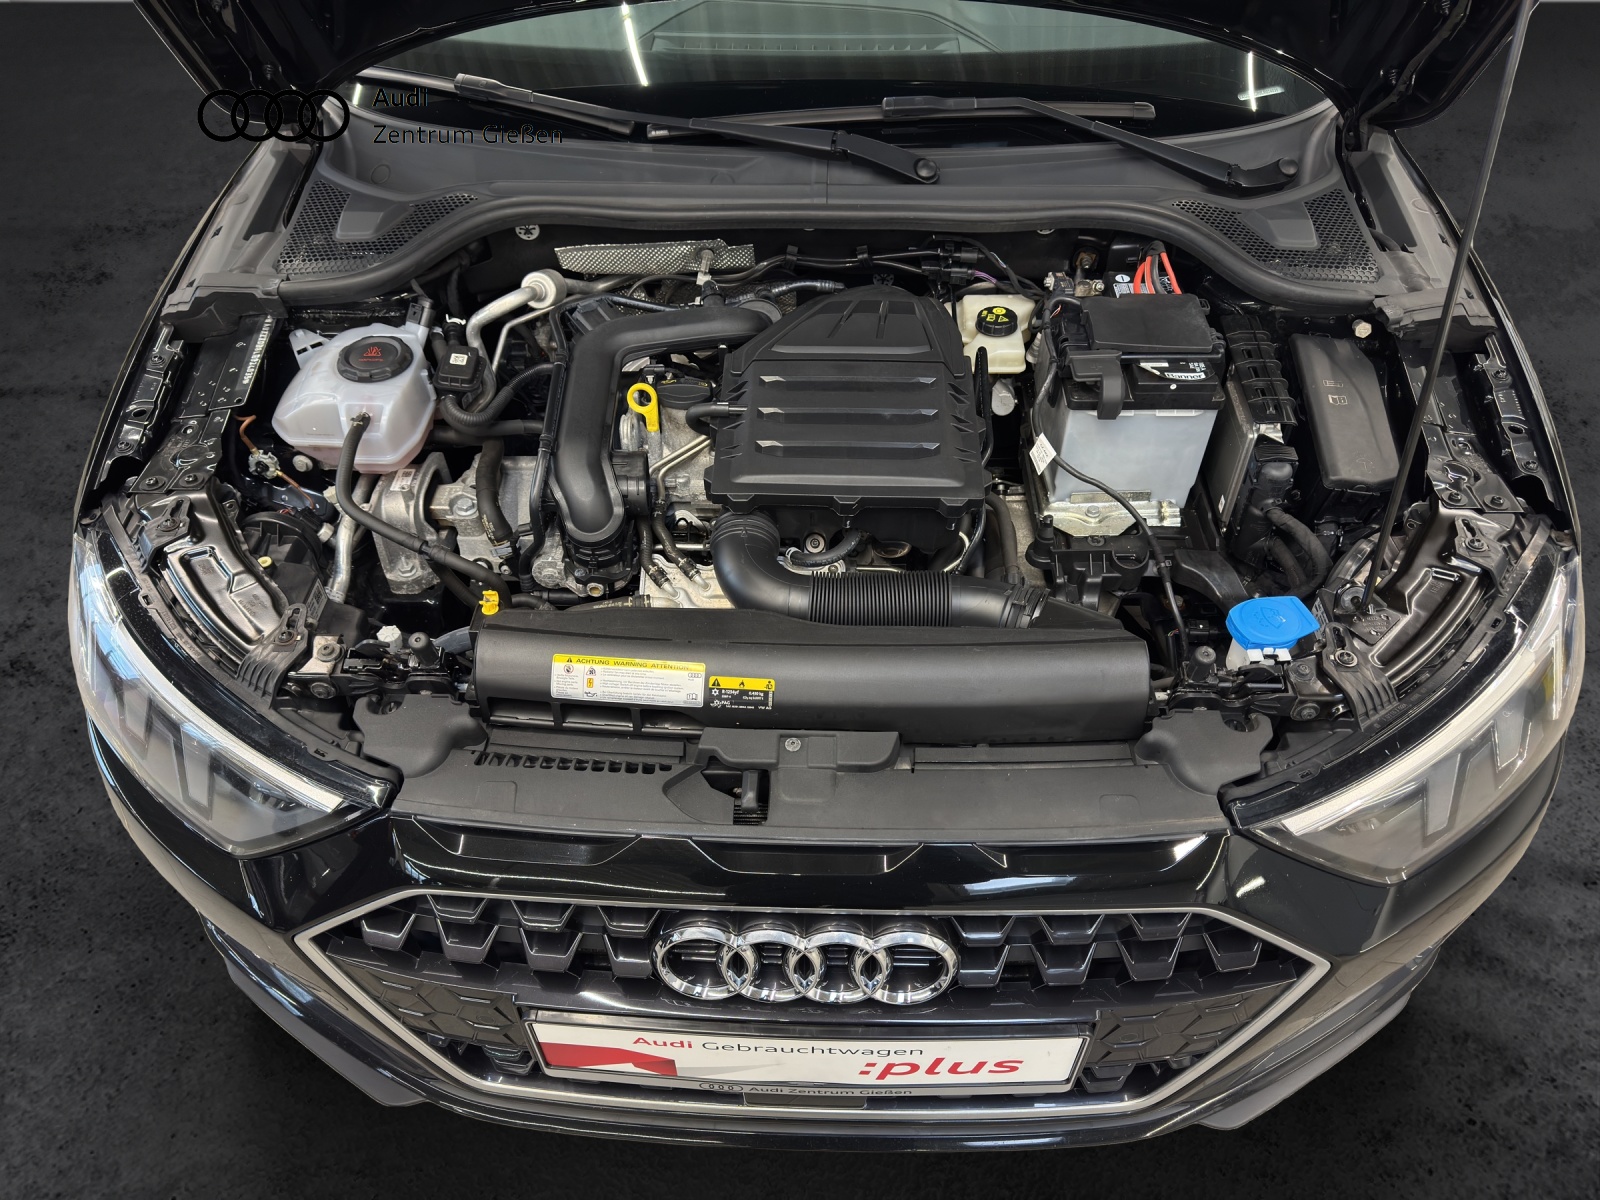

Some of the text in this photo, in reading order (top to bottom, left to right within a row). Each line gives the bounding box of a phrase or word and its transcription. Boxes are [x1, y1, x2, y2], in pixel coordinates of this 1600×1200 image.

[575, 658, 610, 666] ACHTUNG
[613, 660, 648, 669] WARNING
[633, 1037, 924, 1057] Audi Gebrauchtwagen
[858, 1057, 1024, 1080] :plus
